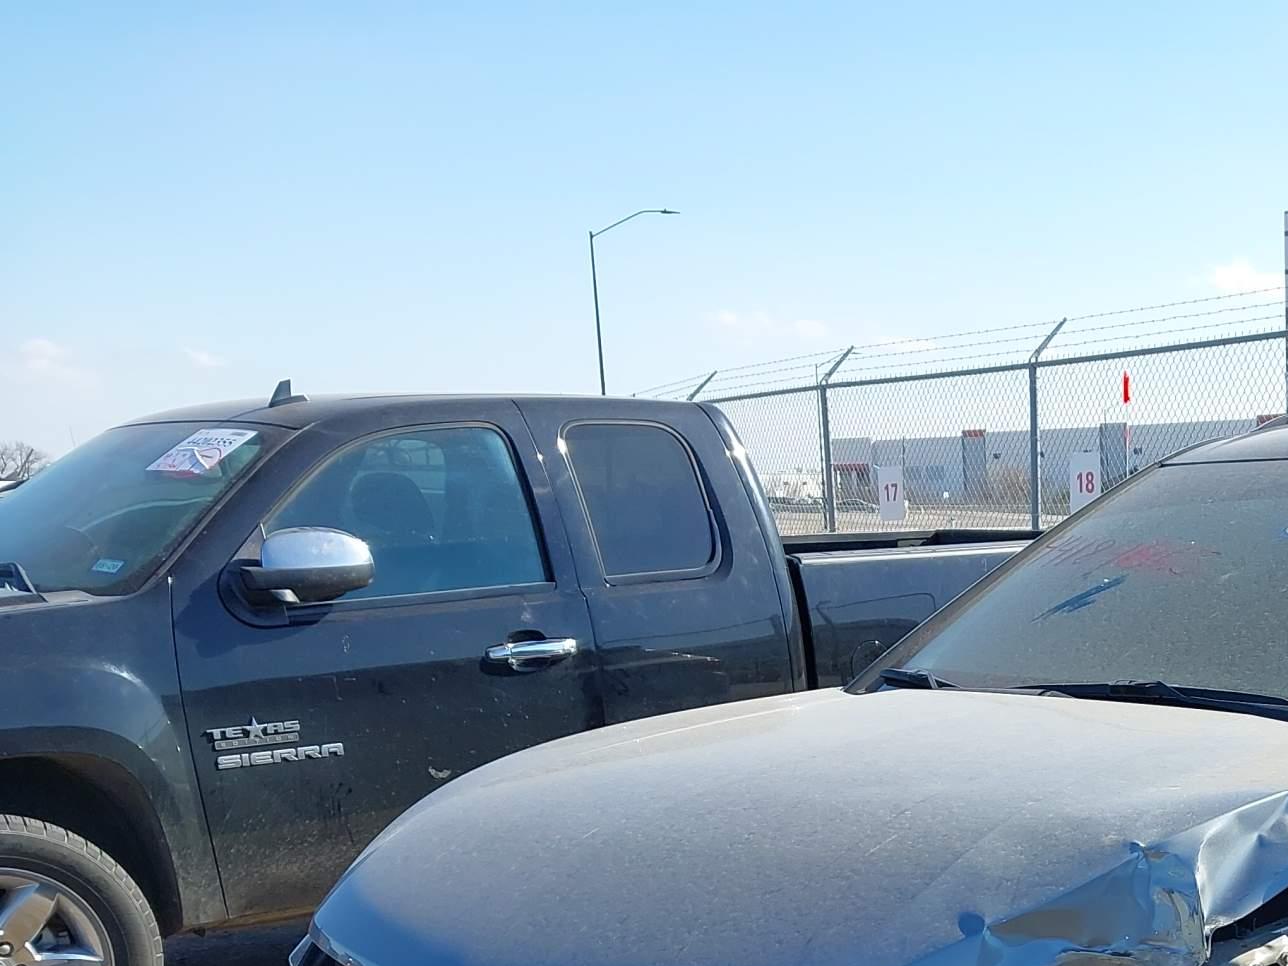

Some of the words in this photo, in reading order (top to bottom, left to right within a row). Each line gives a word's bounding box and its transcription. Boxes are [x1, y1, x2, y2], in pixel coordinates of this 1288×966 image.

[884, 483, 899, 502] 17
[1076, 471, 1095, 494] 18
[206, 717, 301, 740] TEXAS
[216, 742, 345, 770] SIERRA
